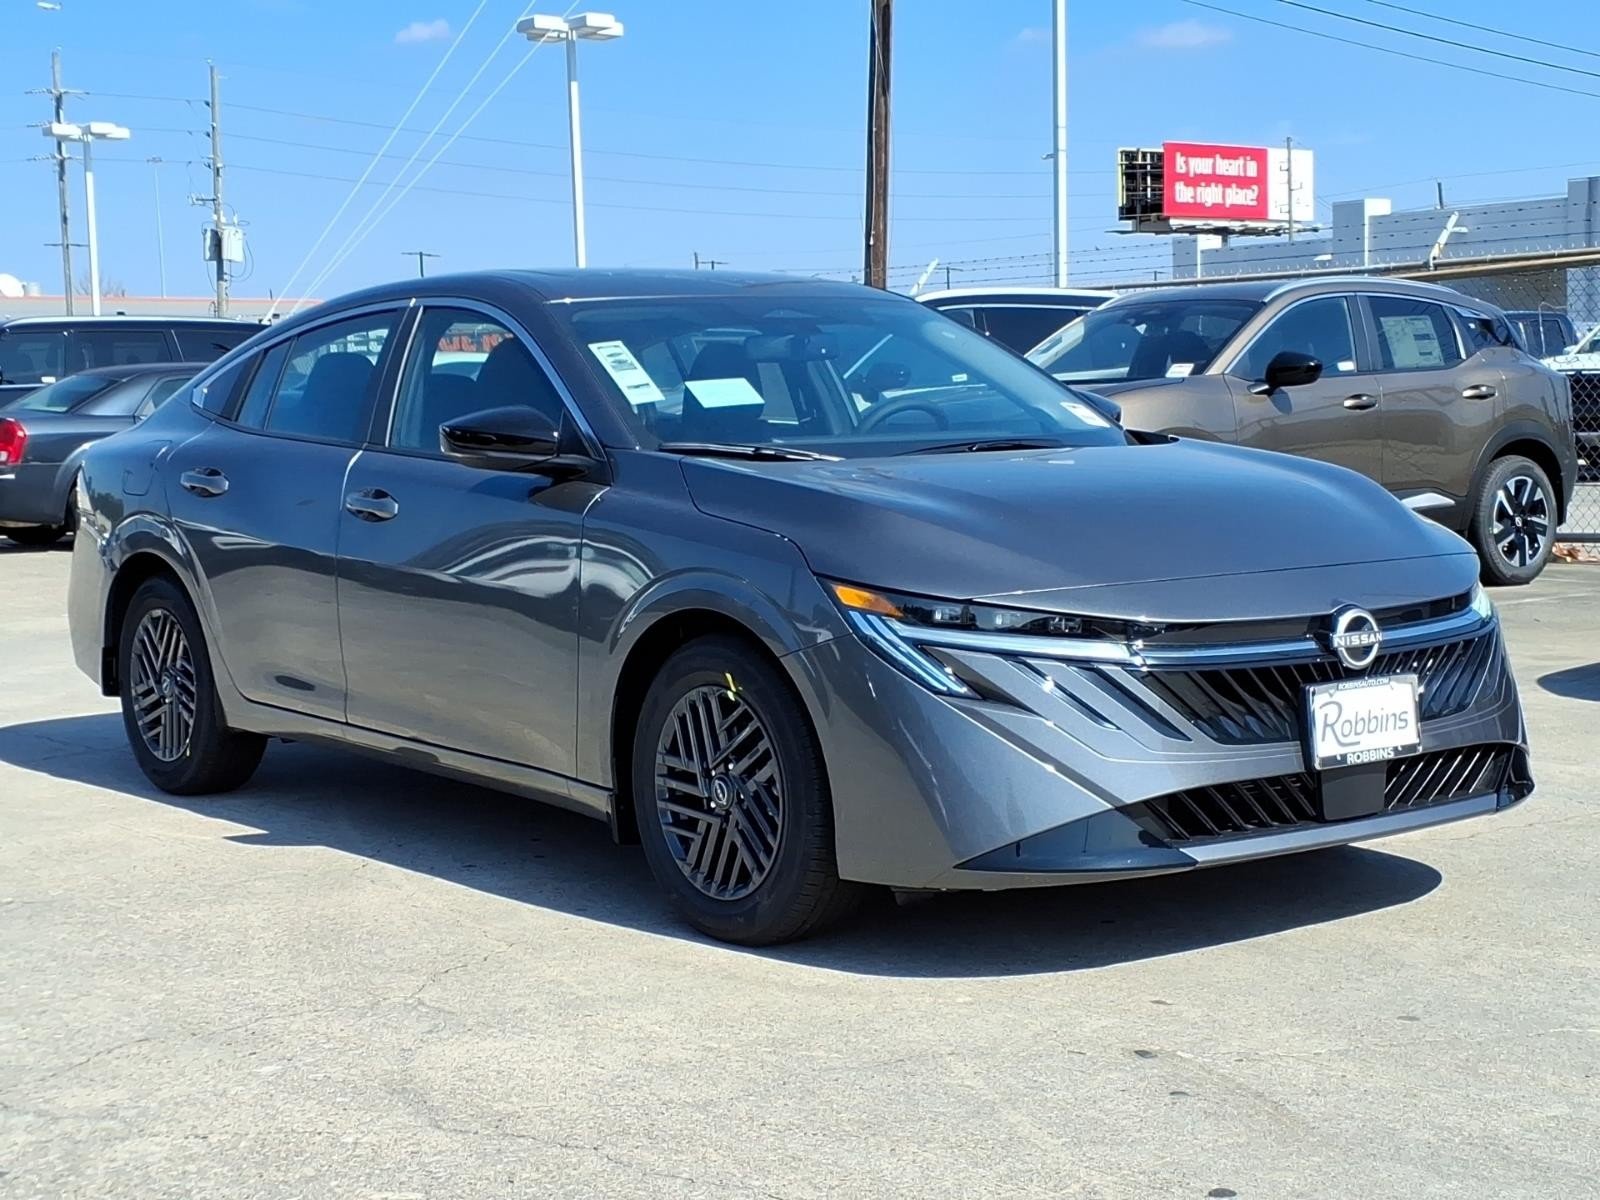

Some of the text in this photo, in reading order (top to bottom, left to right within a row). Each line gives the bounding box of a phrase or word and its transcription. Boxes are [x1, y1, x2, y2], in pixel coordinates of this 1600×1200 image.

[1175, 152, 1258, 177] Is your heart in
[1174, 181, 1258, 208] the right place?
[1333, 631, 1383, 648] NISSAN
[1319, 700, 1409, 747] Robbins
[1346, 747, 1395, 764] ROBBINS
